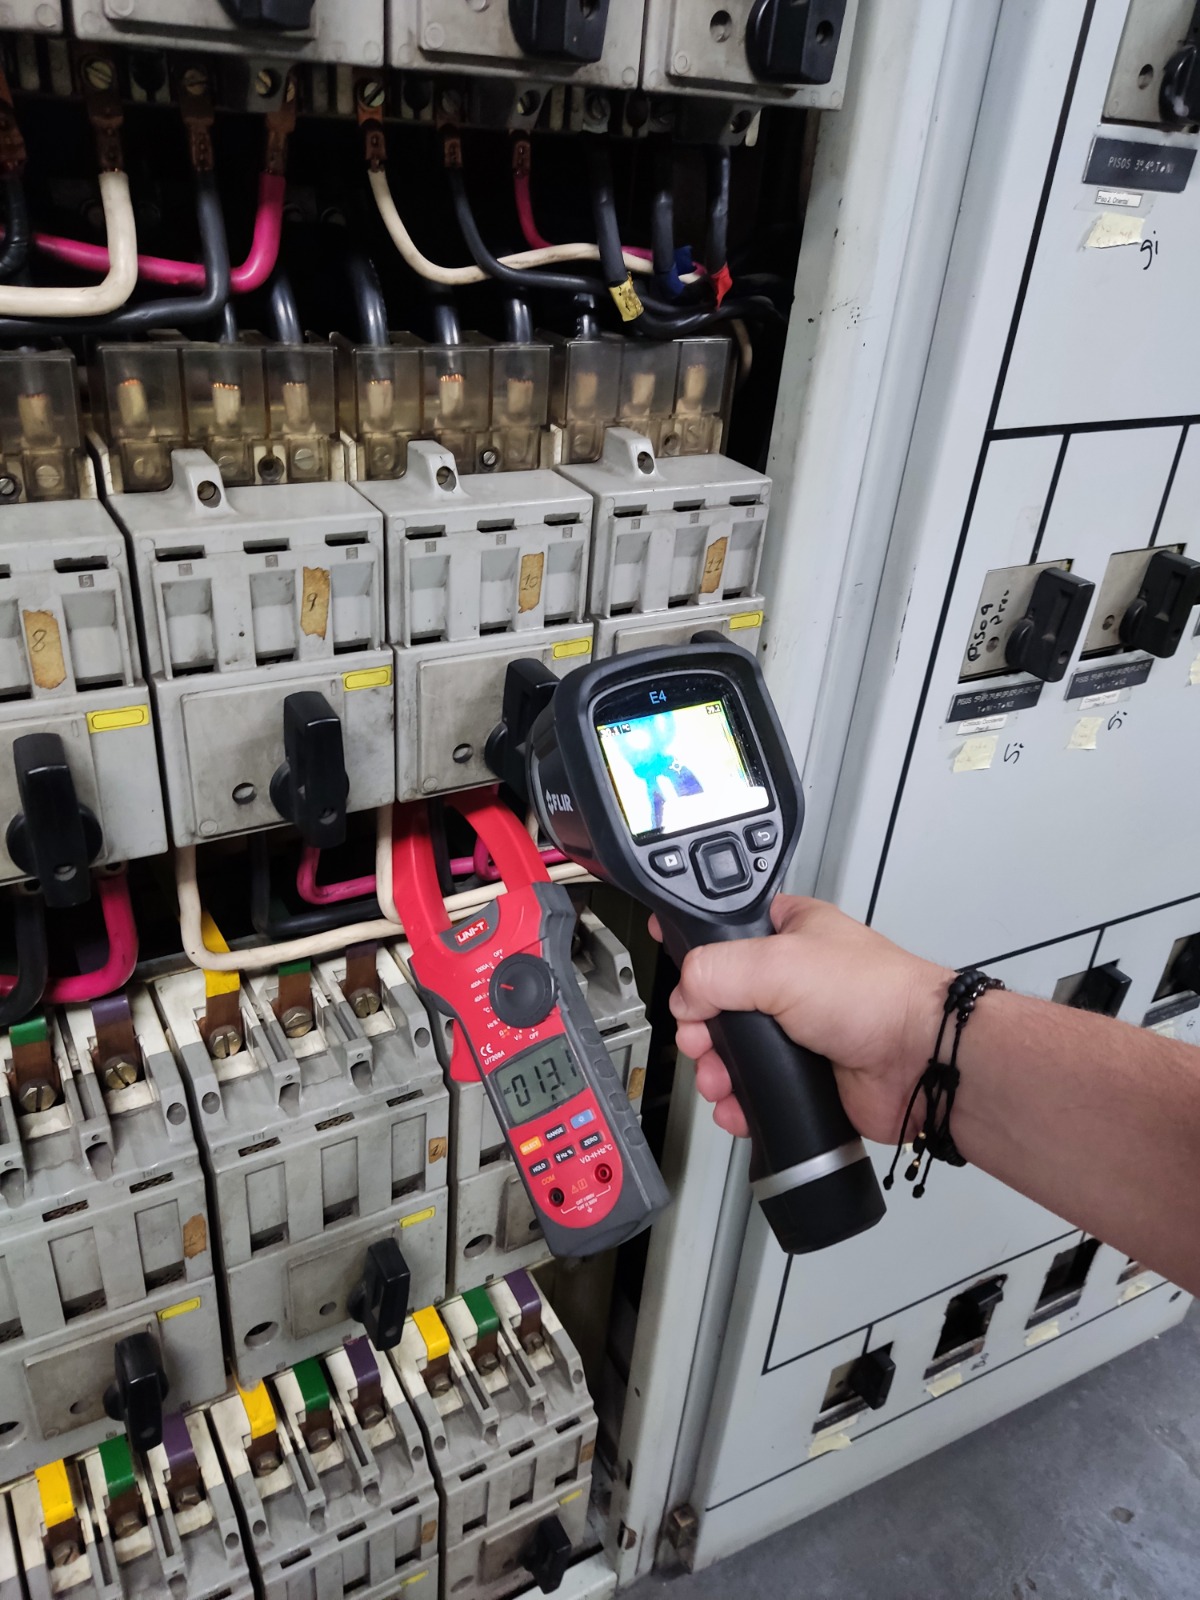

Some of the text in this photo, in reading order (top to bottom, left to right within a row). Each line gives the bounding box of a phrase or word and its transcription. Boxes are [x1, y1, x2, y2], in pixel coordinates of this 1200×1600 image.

[1108, 156, 1132, 170] PISOS
[306, 592, 318, 612] 9
[32, 629, 47, 653] 8
[649, 689, 667, 705] E4
[551, 793, 574, 812] FLIR
[457, 921, 485, 943] UNI-T
[493, 948, 503, 958] OFF
[528, 1031, 539, 1040] OFF
[546, 1126, 564, 1140] RANGE
[583, 1135, 598, 1147] ZERO
[532, 1162, 546, 1173] HOLD
[541, 1174, 556, 1185] COM
